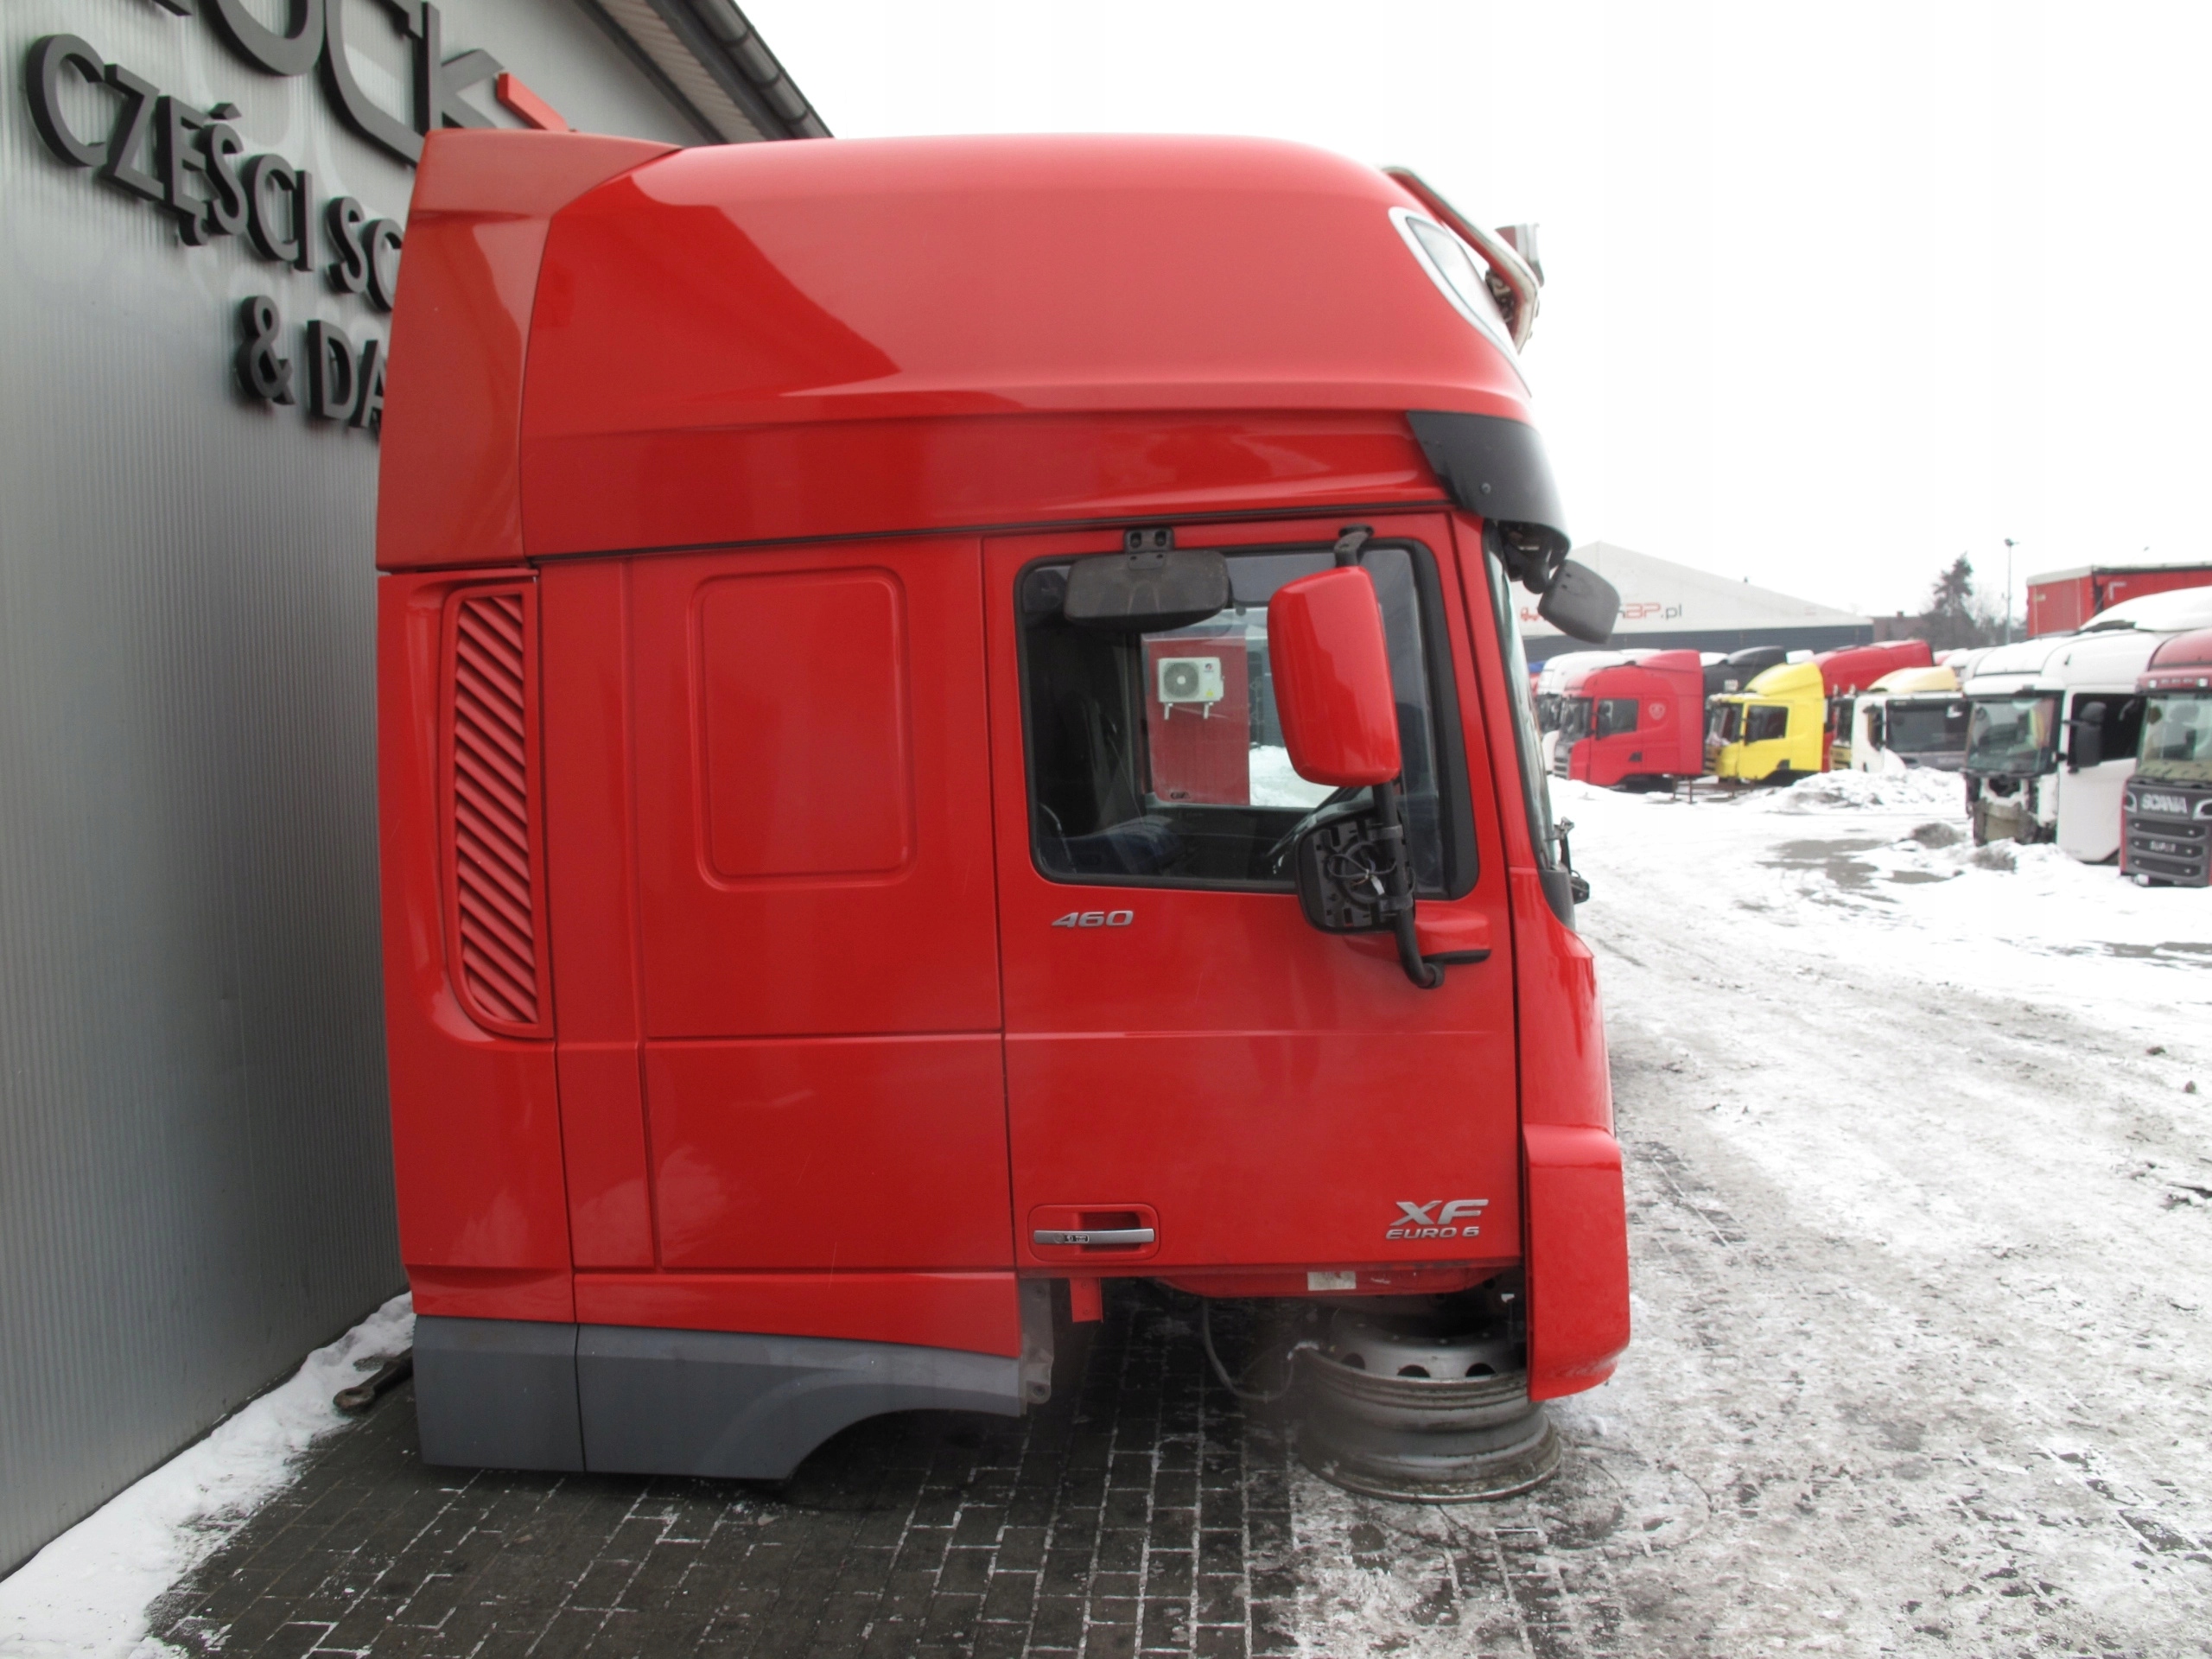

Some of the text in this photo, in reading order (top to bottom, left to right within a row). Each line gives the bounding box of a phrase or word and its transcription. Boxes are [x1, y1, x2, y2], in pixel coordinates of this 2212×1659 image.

[26, 34, 313, 271] CZĘŚCI
[237, 295, 296, 404] &
[1051, 910, 1135, 929] 460
[1389, 1198, 1490, 1227] XF
[1385, 1225, 1480, 1240] EURO 6
